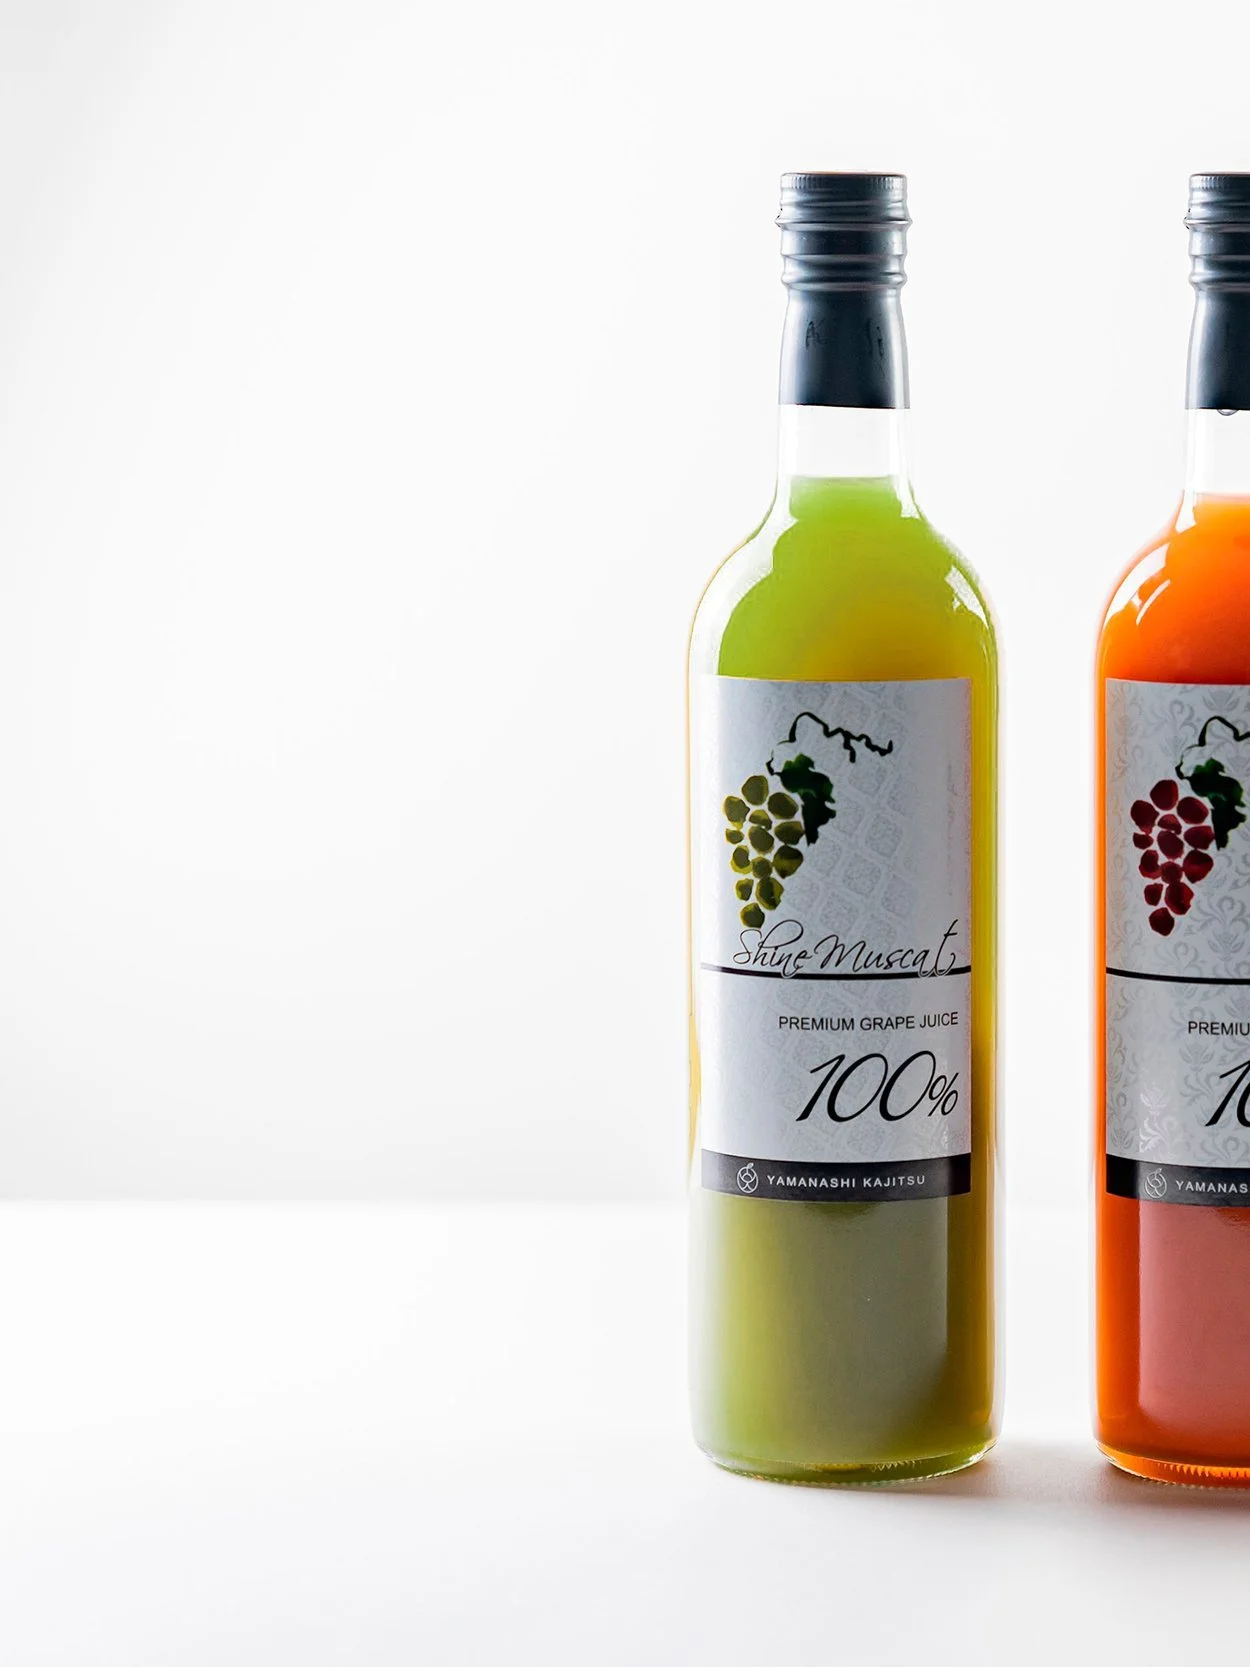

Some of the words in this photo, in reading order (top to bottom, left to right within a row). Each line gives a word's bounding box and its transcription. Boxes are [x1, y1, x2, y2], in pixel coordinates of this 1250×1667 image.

[732, 919, 812, 979] Shine
[812, 919, 959, 978] Muscat
[779, 1015, 854, 1032] PREMIUM
[860, 1014, 915, 1031] GRAPE
[919, 1012, 959, 1029] JUICE
[796, 1050, 959, 1122] 100%
[767, 1174, 856, 1188] YAMANASHI
[863, 1174, 926, 1188] KAJITSU
